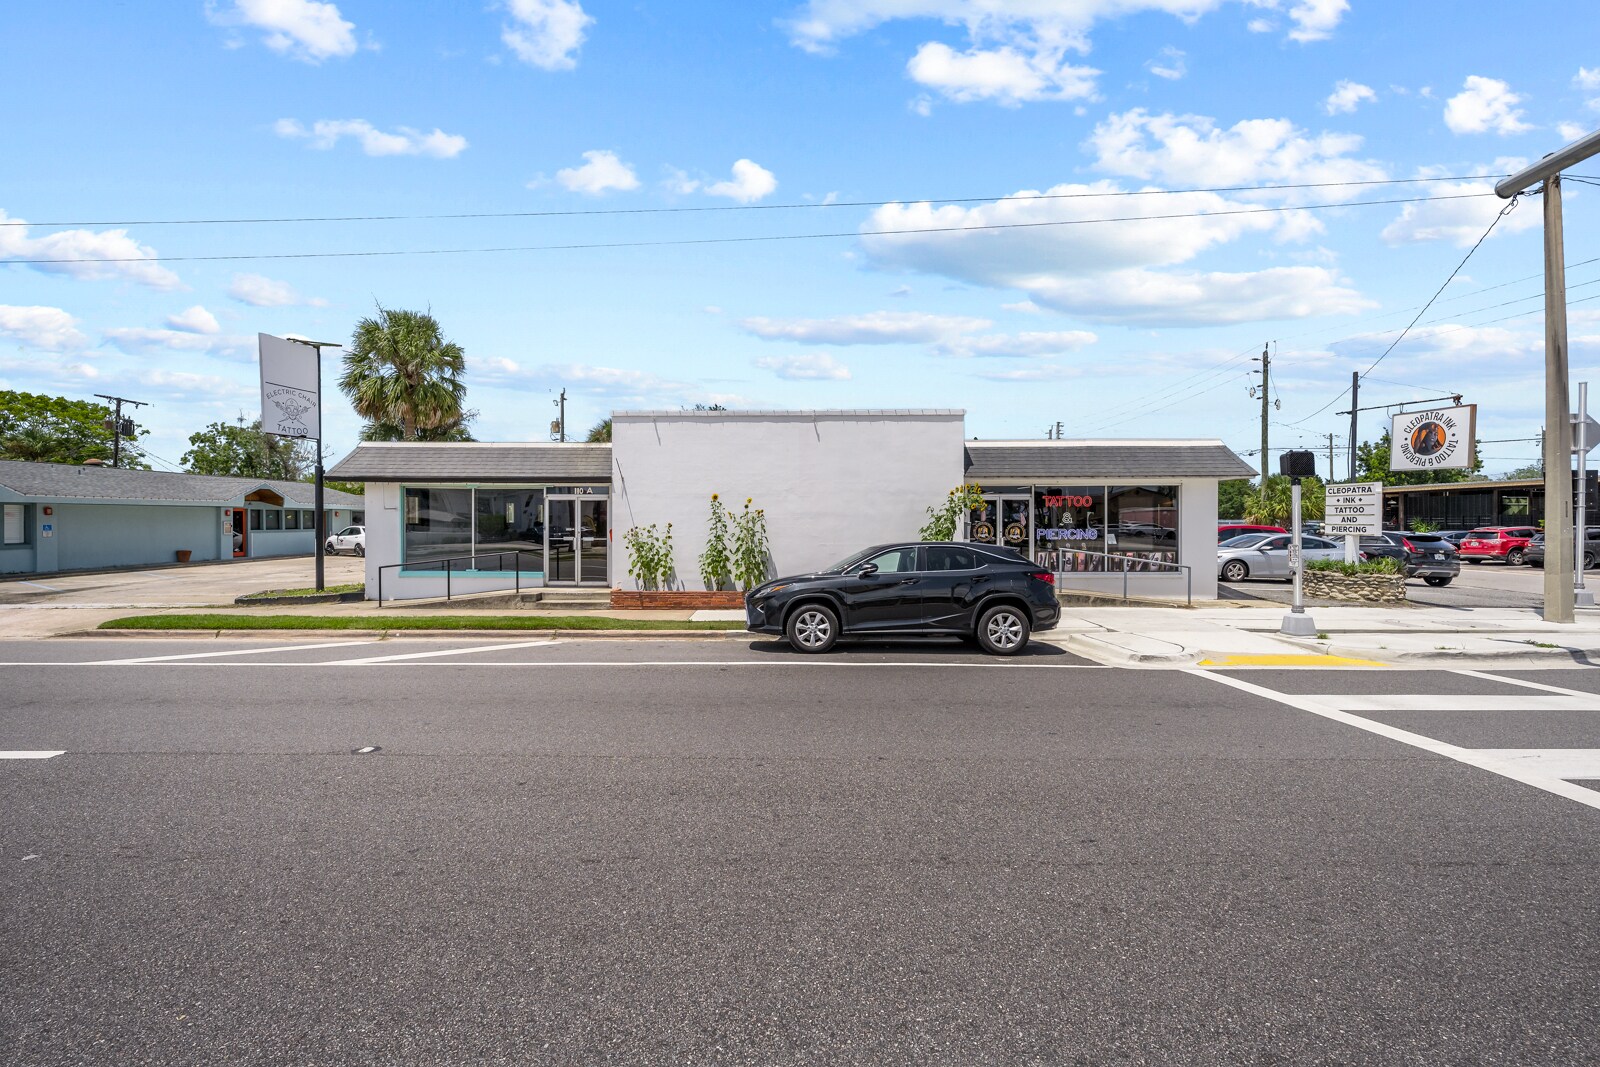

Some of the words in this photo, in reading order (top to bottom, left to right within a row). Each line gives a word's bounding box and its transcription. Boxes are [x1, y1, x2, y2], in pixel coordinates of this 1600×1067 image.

[266, 389, 297, 400] ELECTRIC
[298, 392, 317, 408] CHAIR
[277, 423, 309, 435] TATTOO
[1403, 411, 1445, 434] CLEOPATRA
[1442, 416, 1457, 431] INK
[1400, 443, 1427, 467] PIERCING
[1434, 439, 1459, 465] TATTOO
[574, 487, 584, 495] 110
[1327, 486, 1373, 495] CLEOPATRA
[1042, 495, 1093, 508] TATTOO
[1342, 496, 1356, 504] INK
[1334, 506, 1365, 514] TATTOO
[1061, 511, 1073, 524] &
[1036, 528, 1098, 541] PIERCING
